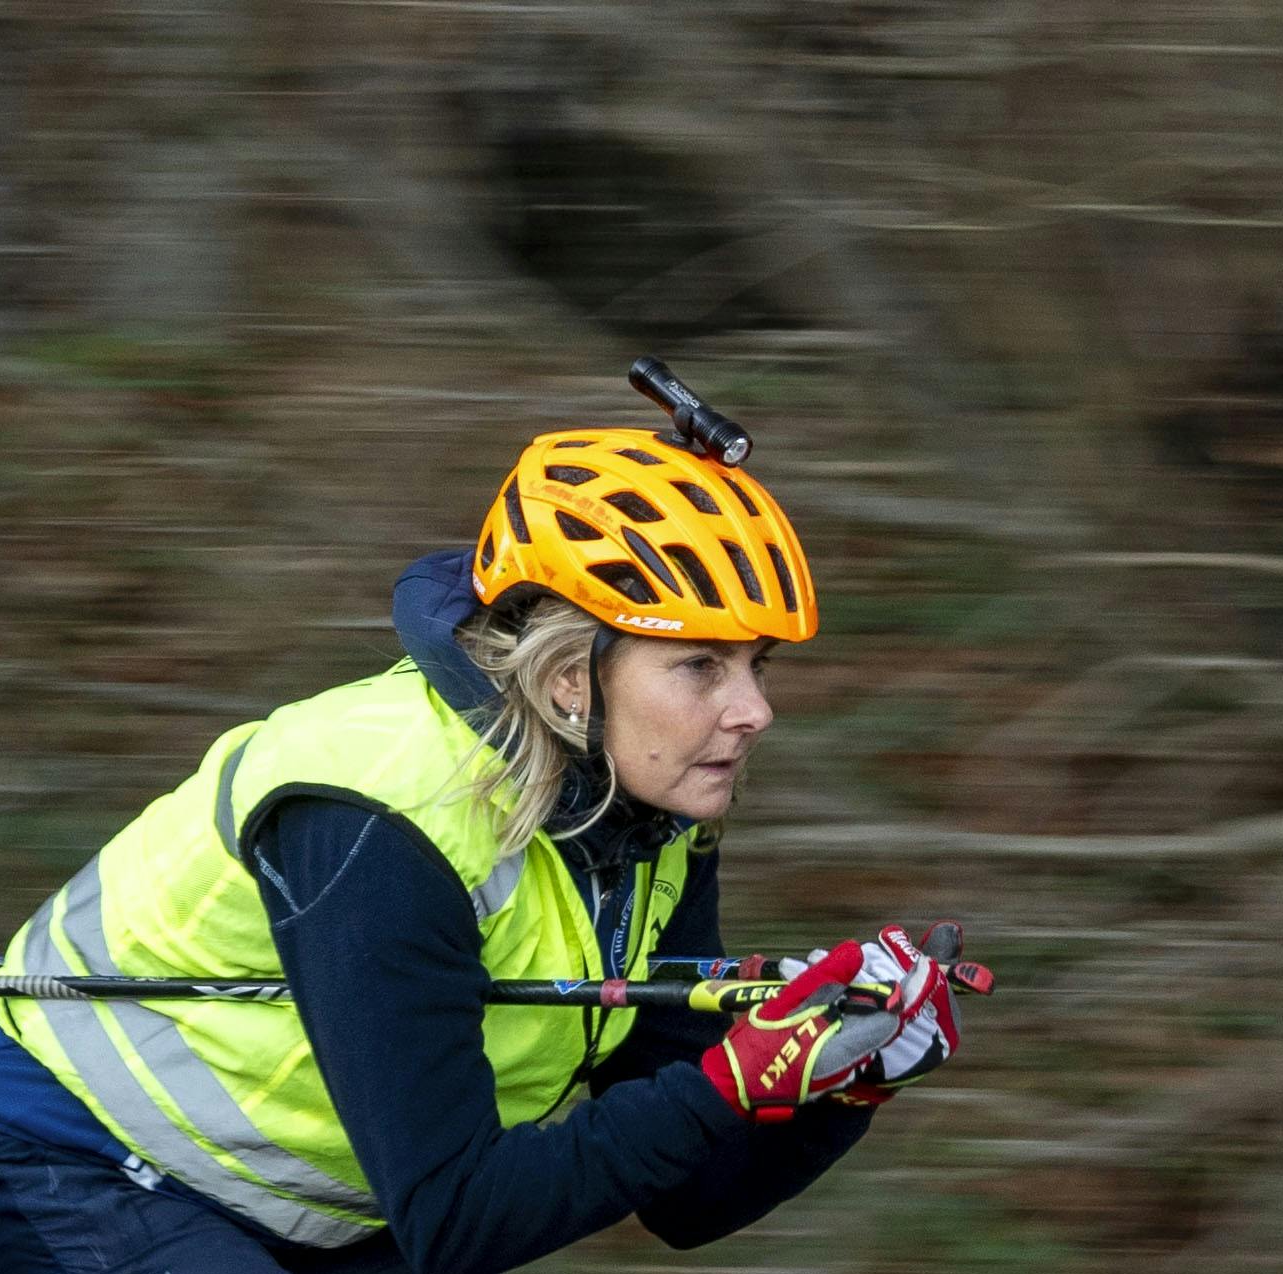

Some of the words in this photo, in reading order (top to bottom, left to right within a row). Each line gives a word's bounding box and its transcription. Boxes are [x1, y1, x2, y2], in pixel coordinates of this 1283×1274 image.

[615, 614, 684, 631] LAZER
[735, 986, 781, 1002] LEK
[759, 1018, 818, 1090] LEKI
